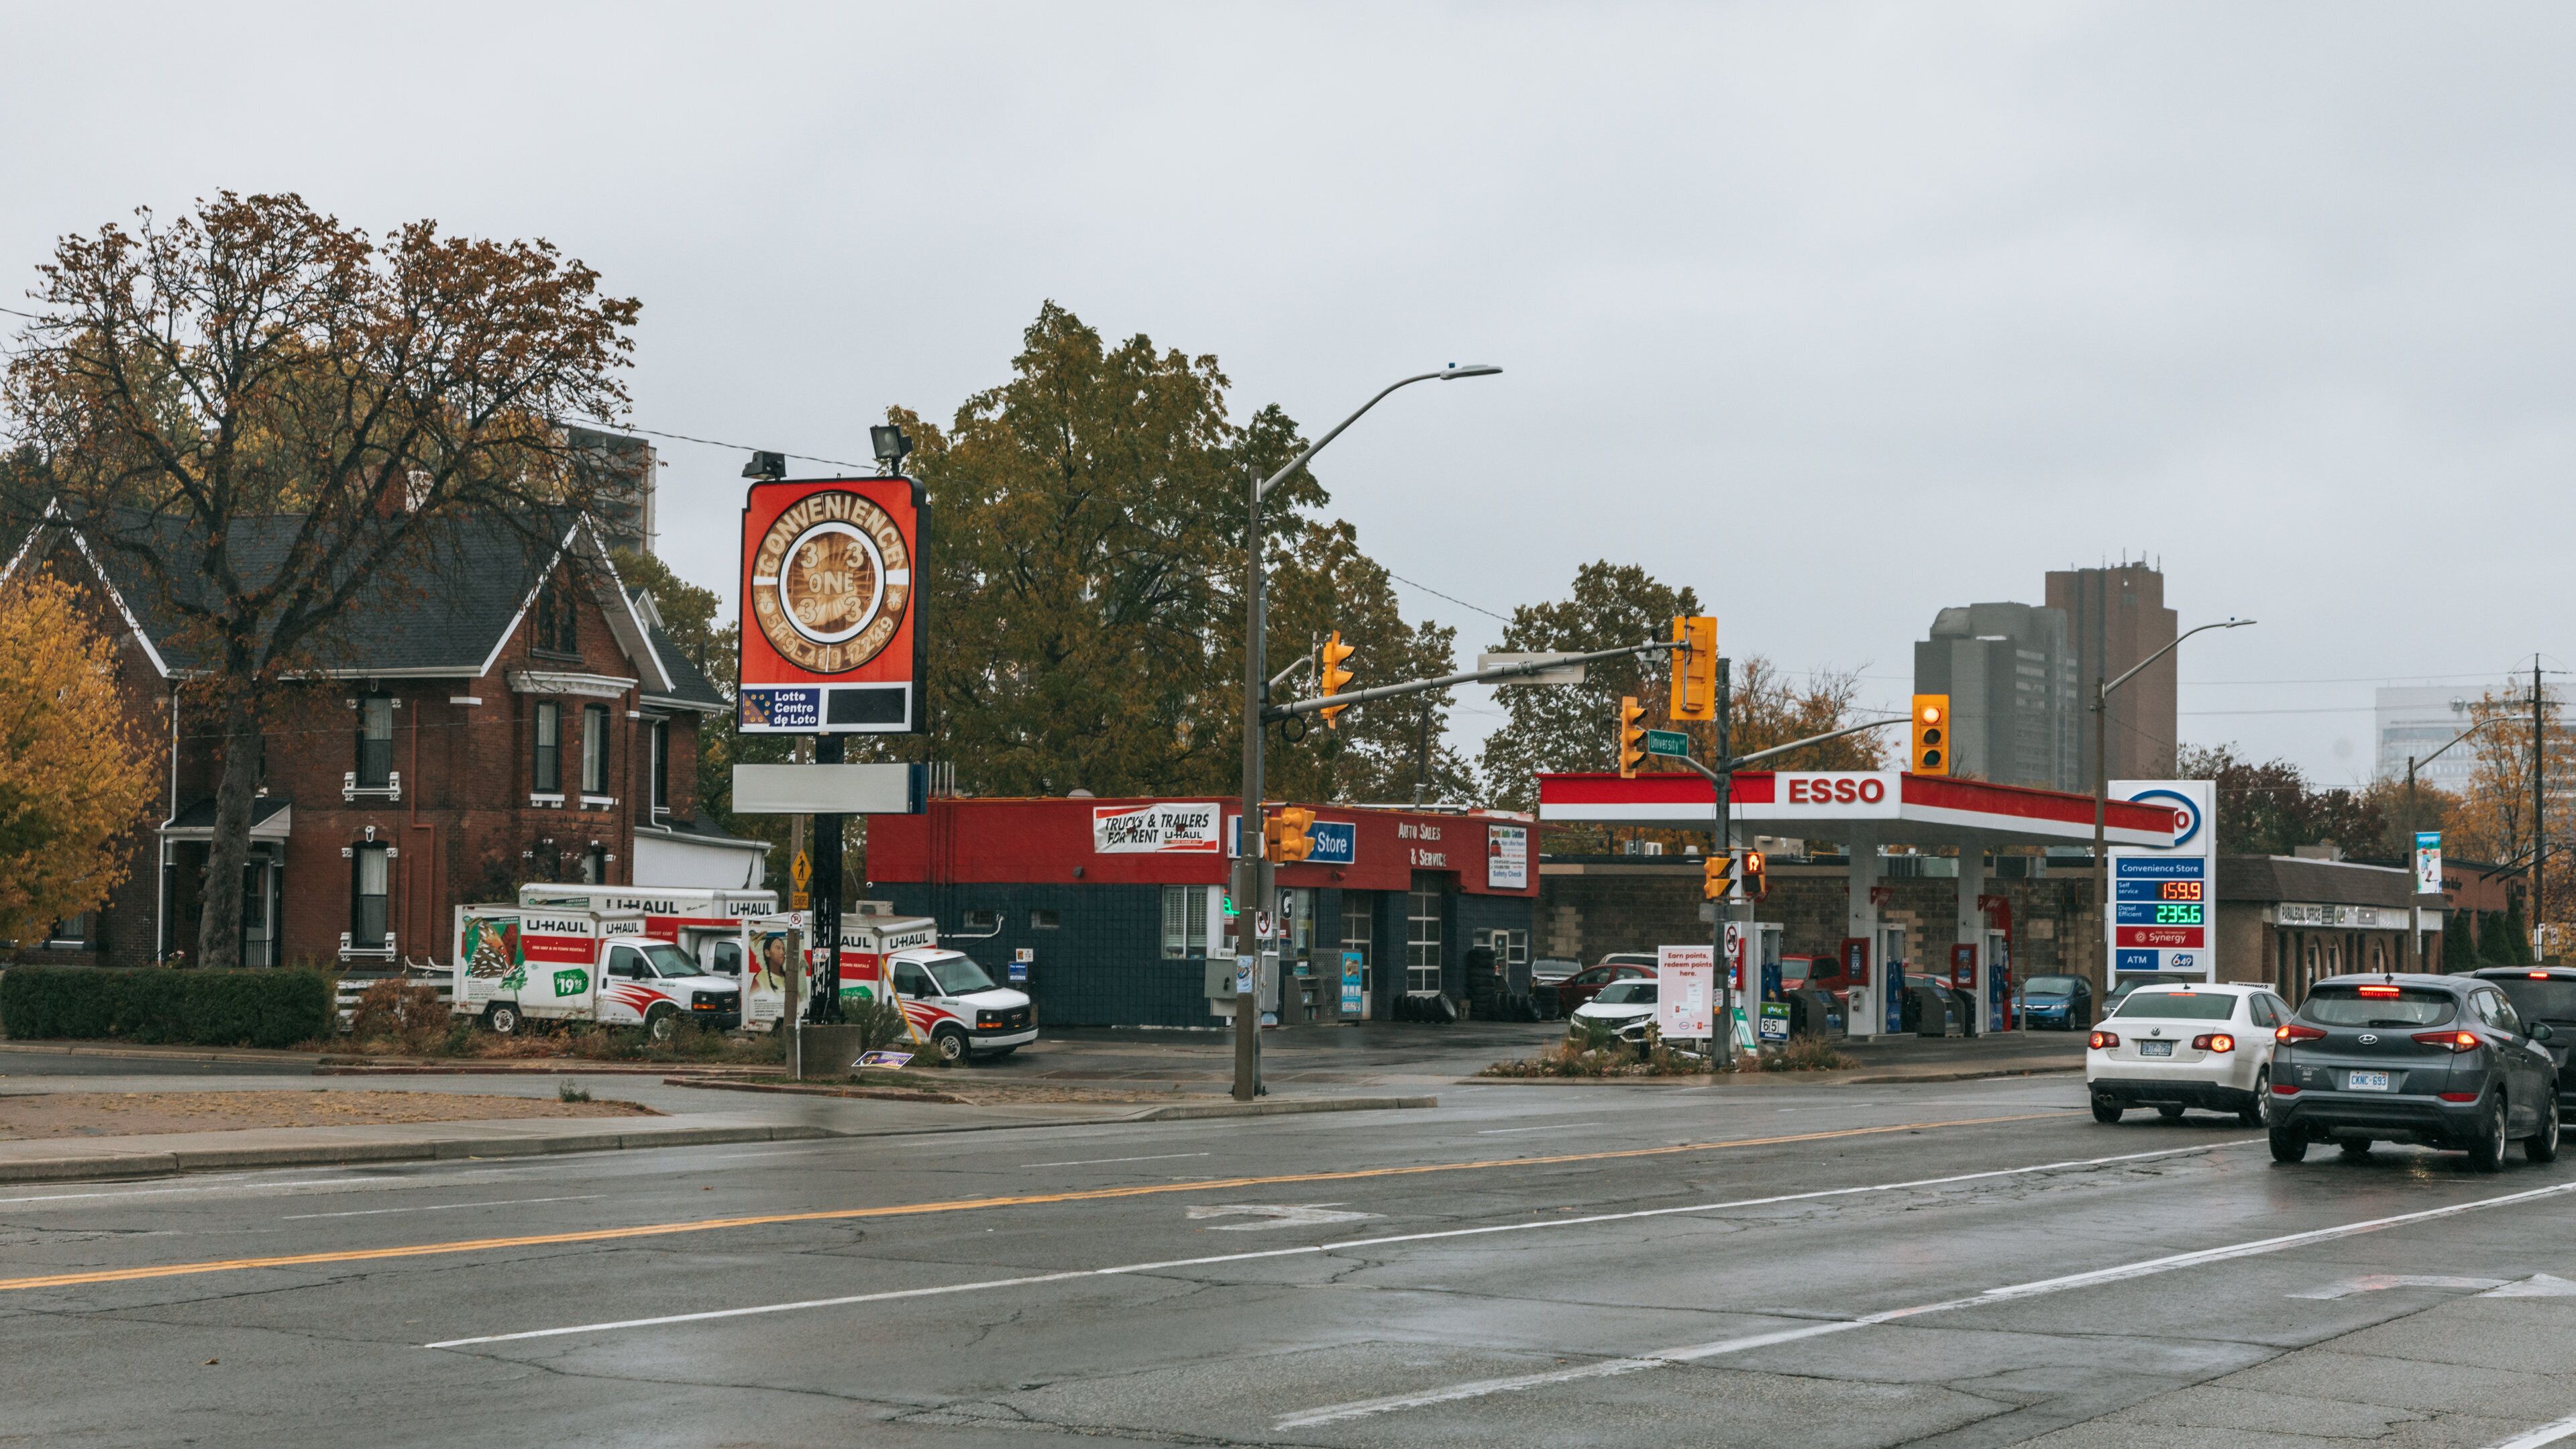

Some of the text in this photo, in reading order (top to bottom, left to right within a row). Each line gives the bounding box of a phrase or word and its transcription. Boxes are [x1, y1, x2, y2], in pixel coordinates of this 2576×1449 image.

[759, 494, 905, 574] CONVENIENCE
[800, 541, 864, 569] 3 3
[809, 570, 855, 596] ONE
[798, 596, 863, 625] 3 3
[775, 691, 806, 702] Lotto
[775, 703, 814, 714] Centre
[774, 714, 816, 725] de Loto
[1651, 735, 1679, 755] University
[1788, 778, 1885, 804] ESSO
[1106, 813, 1210, 831] TRUCKS & TRAILERS
[1108, 829, 1159, 844] FOR RENT
[1318, 831, 1347, 854] Store
[1411, 848, 1417, 865] &
[1493, 870, 1507, 878] Safety
[2122, 864, 2174, 872] Convenience
[2163, 882, 2201, 900] 159.9
[2157, 905, 2201, 923] 235.6
[840, 936, 871, 948] AUL
[2149, 932, 2186, 944] Synergy
[1691, 961, 1713, 969] points
